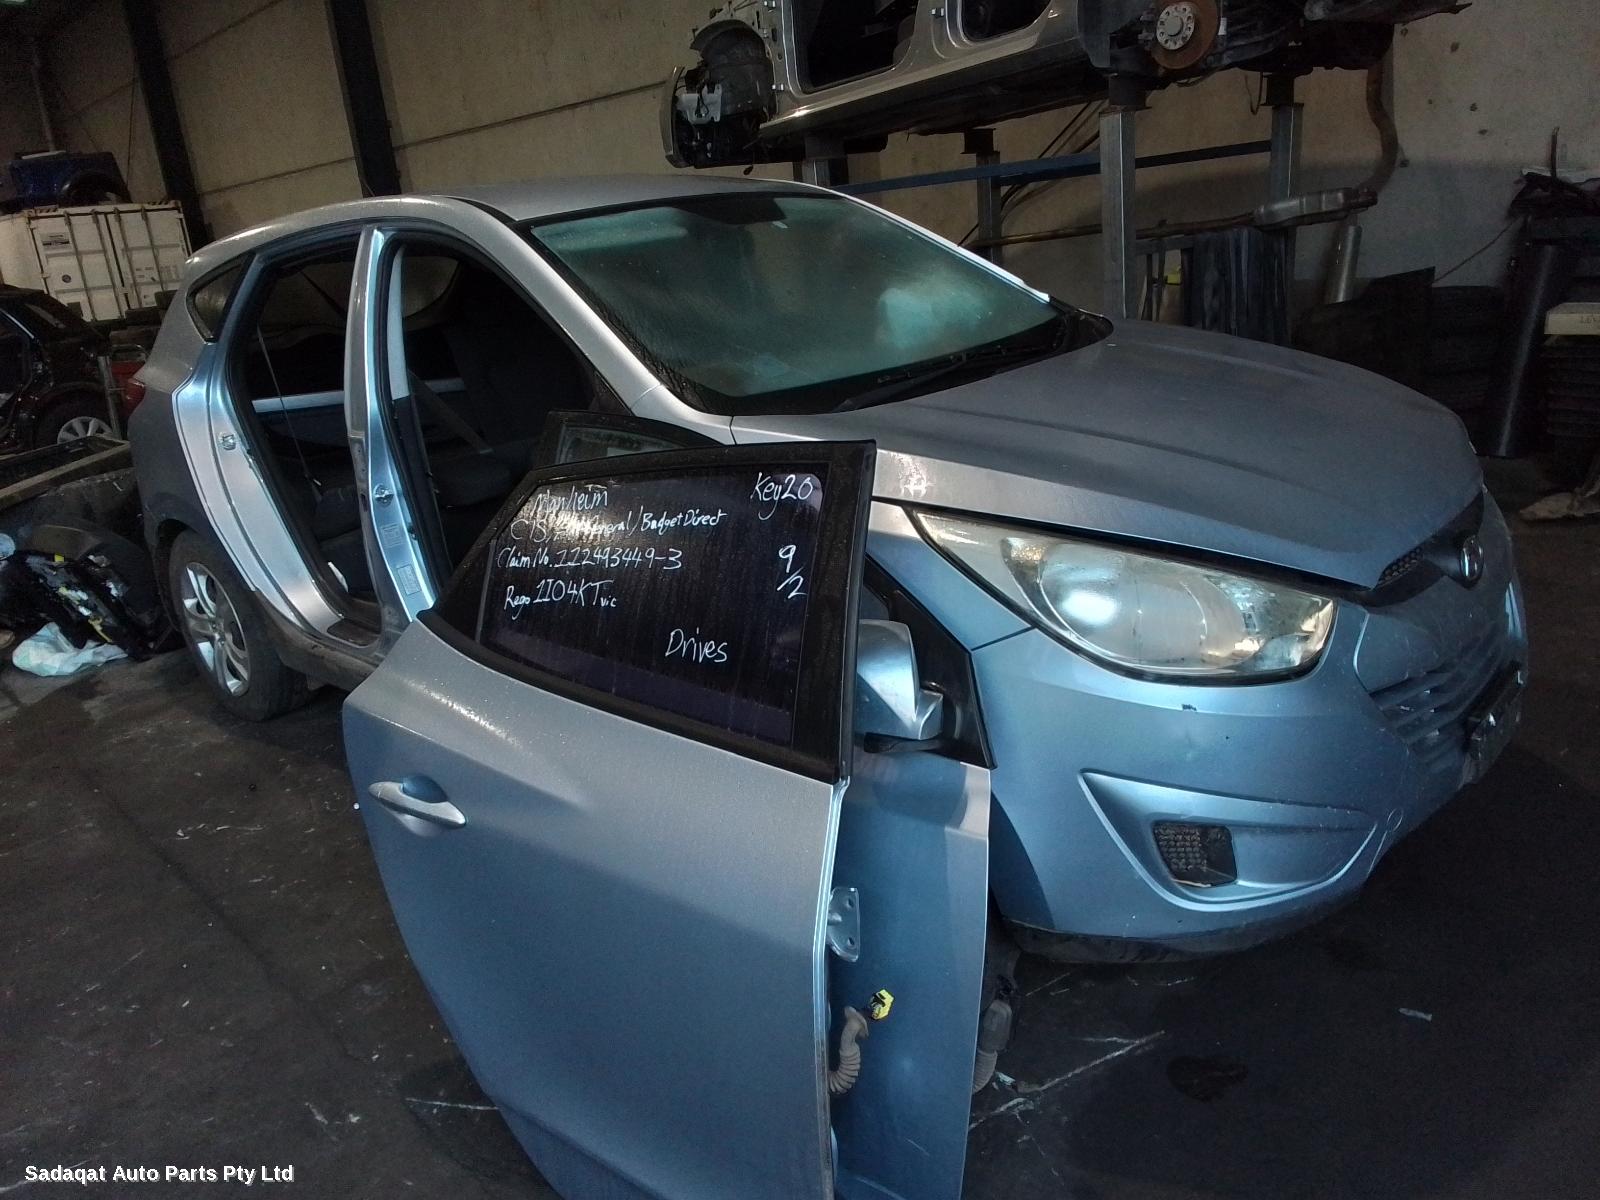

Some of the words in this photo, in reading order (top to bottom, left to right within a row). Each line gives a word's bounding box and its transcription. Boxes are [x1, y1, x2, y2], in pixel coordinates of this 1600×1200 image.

[750, 472, 782, 520] Key
[497, 545, 531, 568] Claim
[503, 585, 531, 620] Rego
[664, 626, 728, 663] Drives
